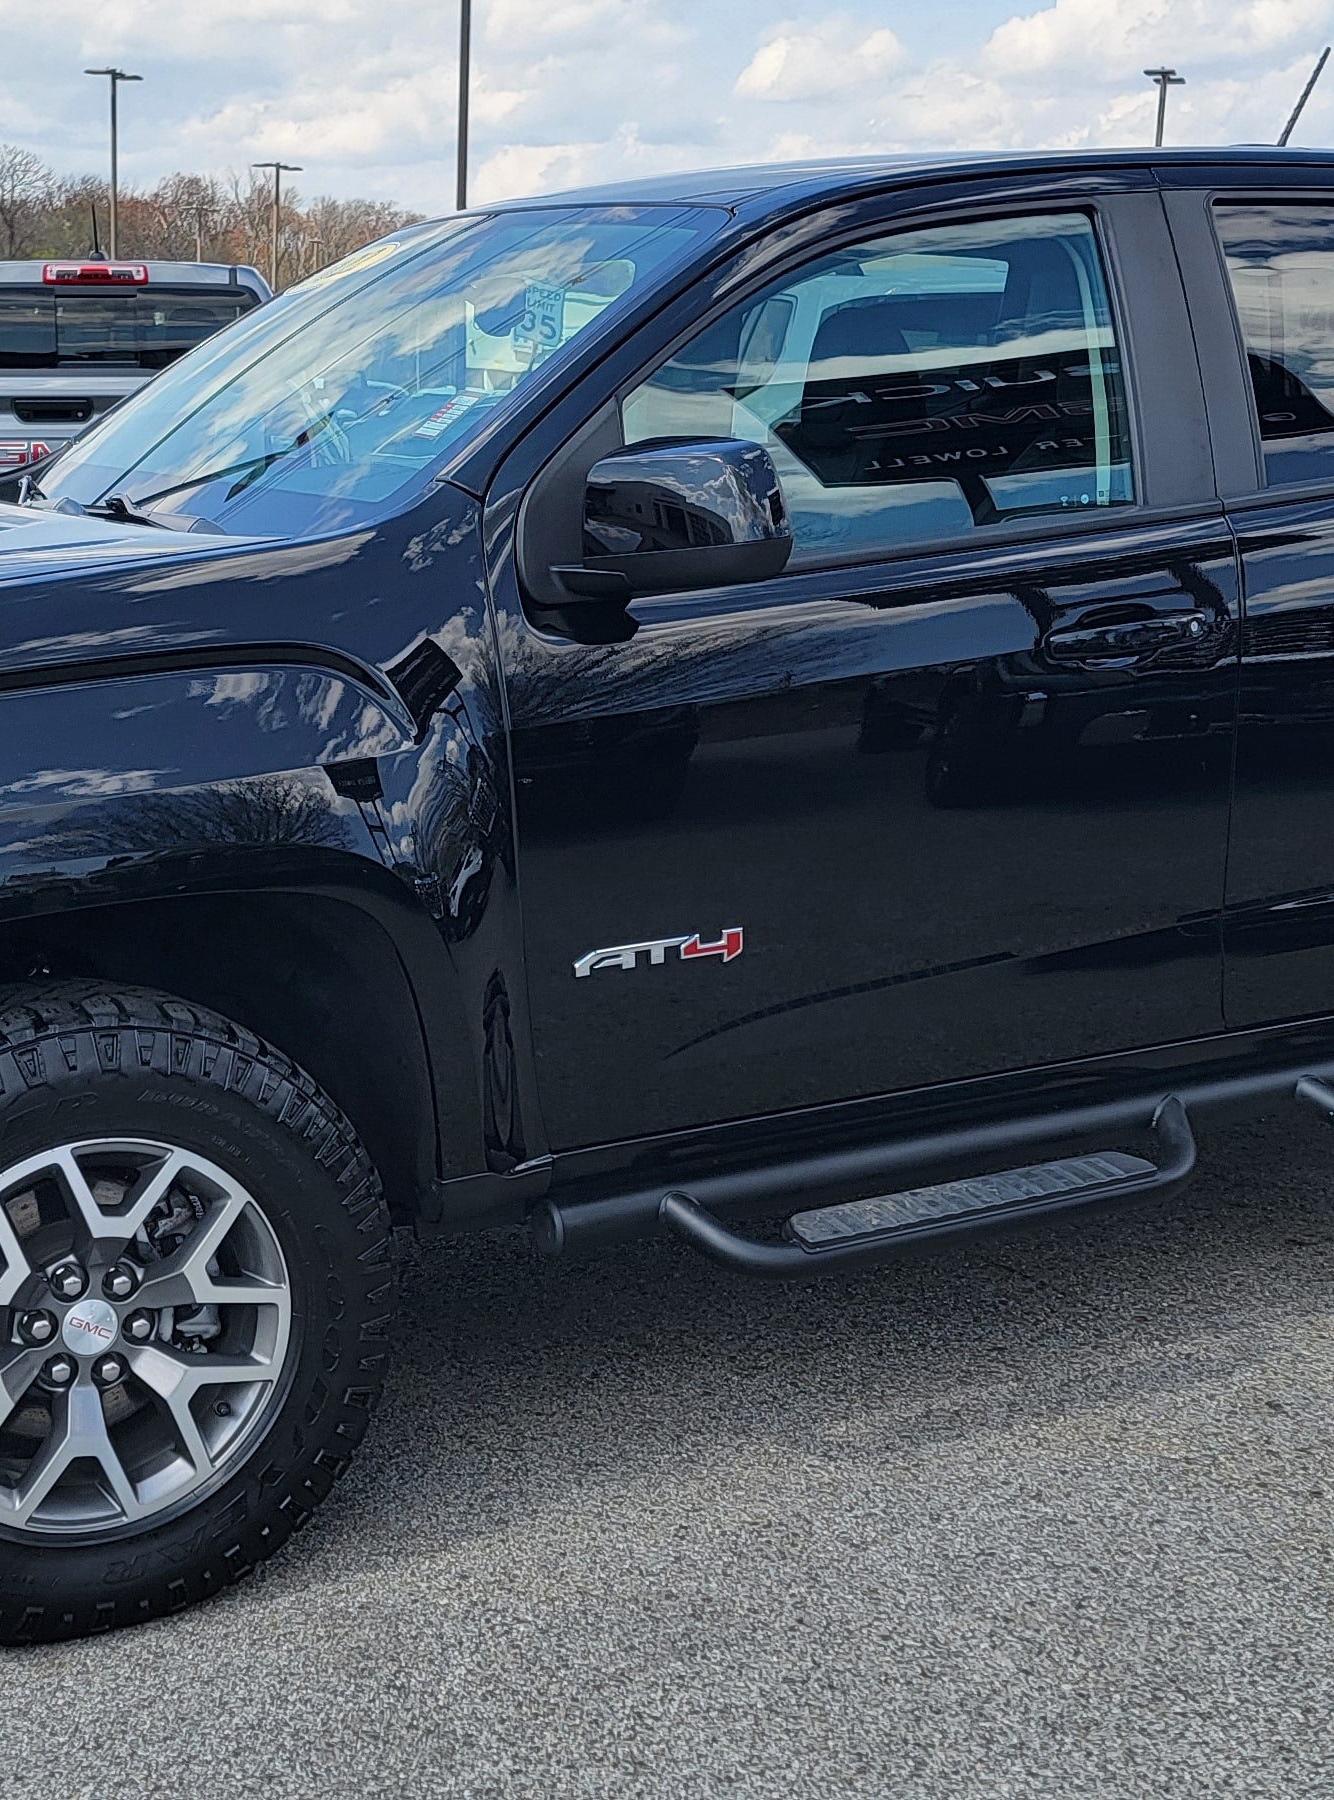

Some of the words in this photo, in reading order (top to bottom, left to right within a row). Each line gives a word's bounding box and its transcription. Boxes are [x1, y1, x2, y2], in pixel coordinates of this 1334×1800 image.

[521, 310, 557, 340] 35
[573, 927, 743, 978] AT4
[69, 1316, 113, 1340] GMC
